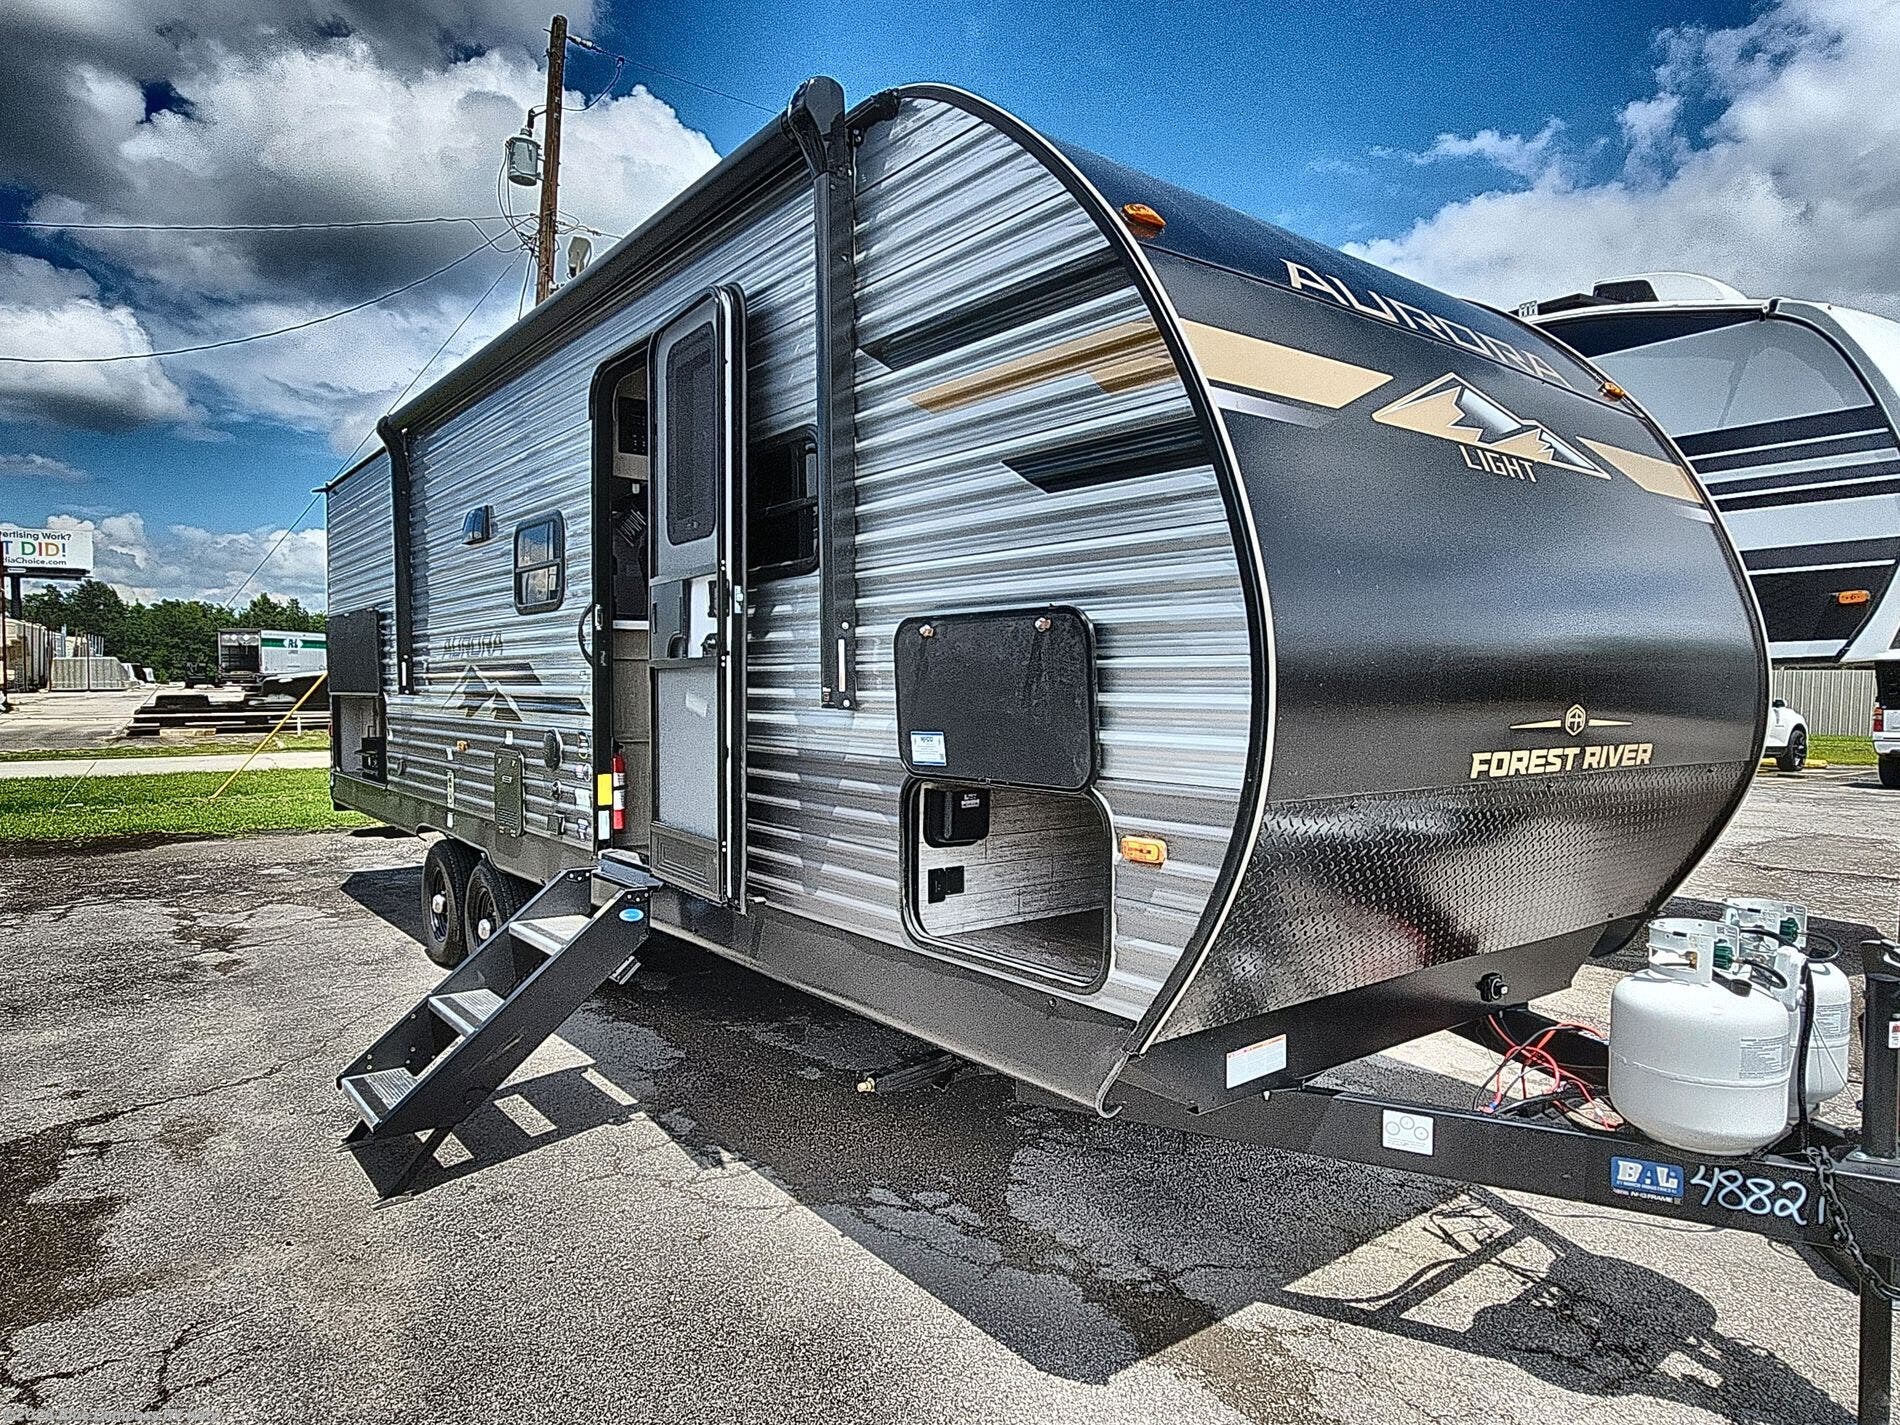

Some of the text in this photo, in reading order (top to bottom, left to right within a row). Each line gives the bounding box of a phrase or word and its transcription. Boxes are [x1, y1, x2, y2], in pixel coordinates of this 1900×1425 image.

[1279, 258, 1573, 389] AURORA
[1458, 444, 1537, 483] LIGHT
[0, 531, 72, 541] ertising Work?
[21, 541, 66, 557] DID!
[441, 634, 503, 660] AURORA
[1470, 743, 1653, 779] FOREST RIVER
